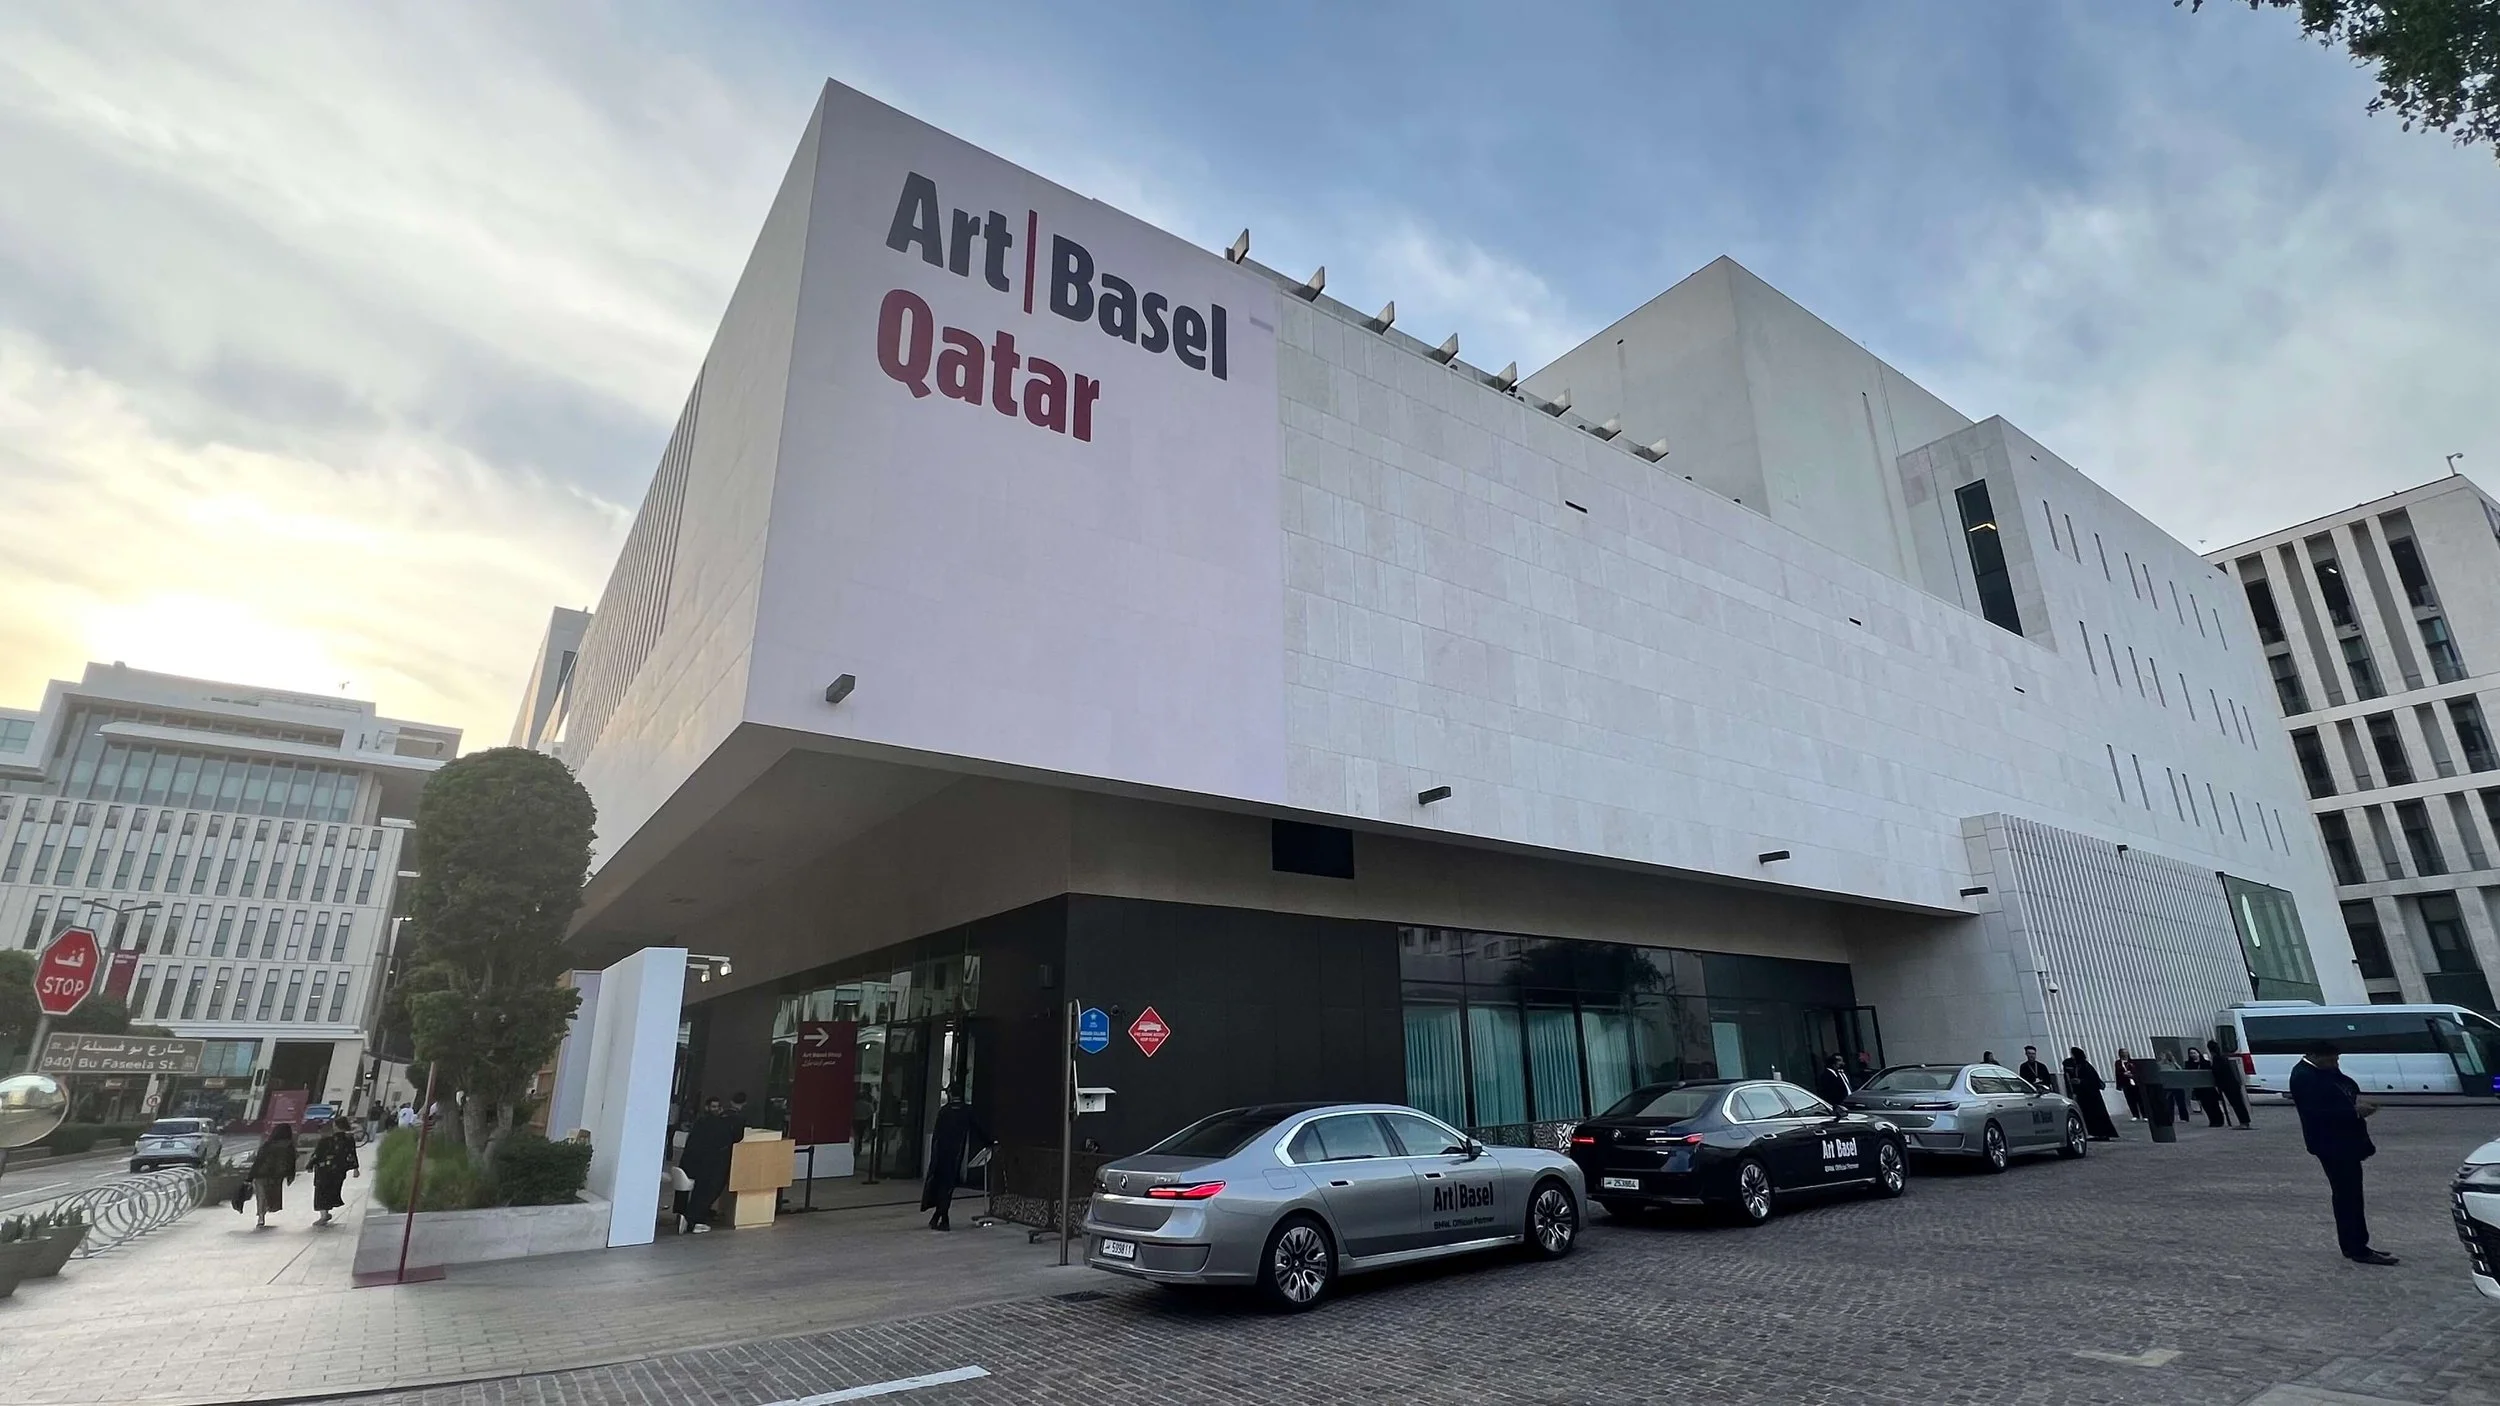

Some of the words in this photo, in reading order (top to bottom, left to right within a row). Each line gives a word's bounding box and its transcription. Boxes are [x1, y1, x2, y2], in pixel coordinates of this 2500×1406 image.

[886, 171, 1013, 292] Art
[1049, 233, 1228, 381] Basel
[877, 288, 1100, 443] Qatar
[55, 947, 85, 967] قف
[42, 976, 85, 996] STOP
[147, 1044, 186, 1056] شارع
[43, 1057, 72, 1068] 940
[78, 1058, 97, 1068] Bu
[1822, 1140, 1835, 1159] Art
[1836, 1137, 1857, 1157] Basel
[1433, 1186, 1454, 1212] Art
[1459, 1181, 1494, 1208] Basel
